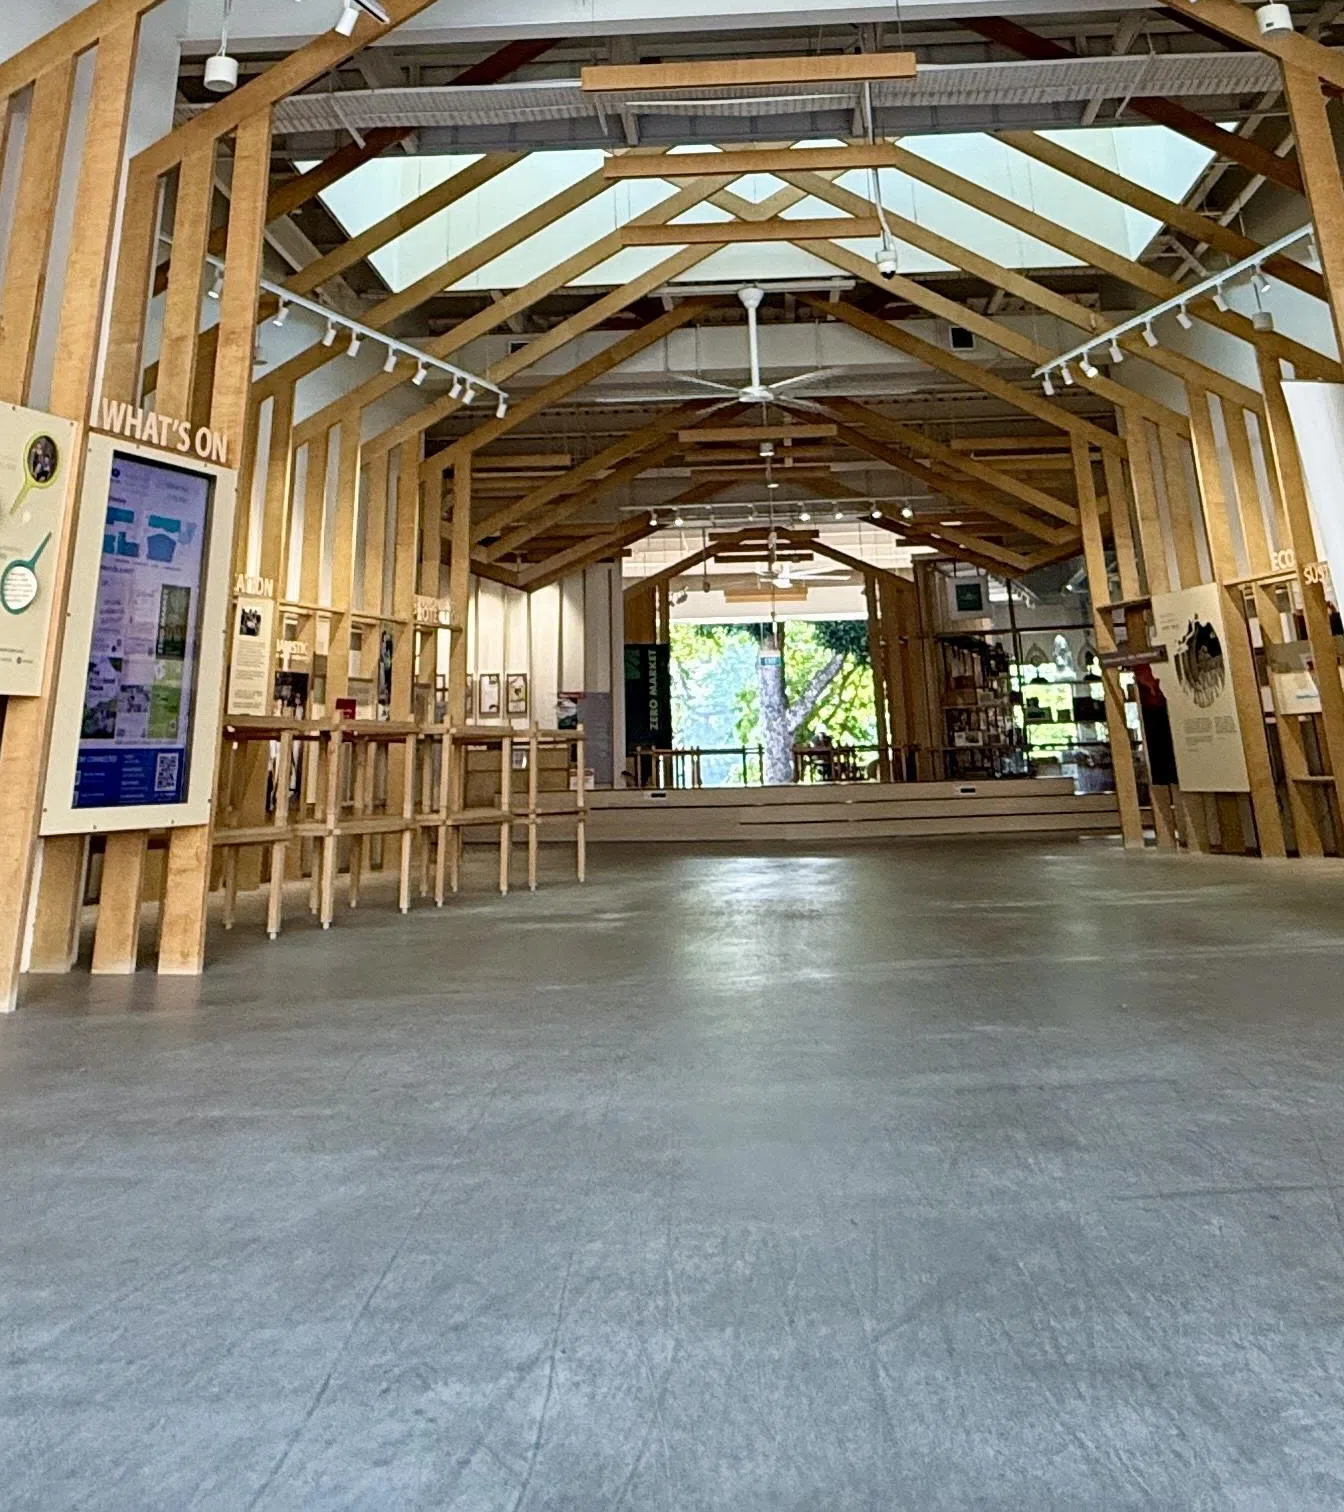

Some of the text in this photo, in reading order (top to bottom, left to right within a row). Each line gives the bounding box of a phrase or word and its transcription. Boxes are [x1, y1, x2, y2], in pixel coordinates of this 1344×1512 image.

[102, 397, 227, 463] WHAT'S ON
[647, 649, 659, 731] ZERO MARKET
